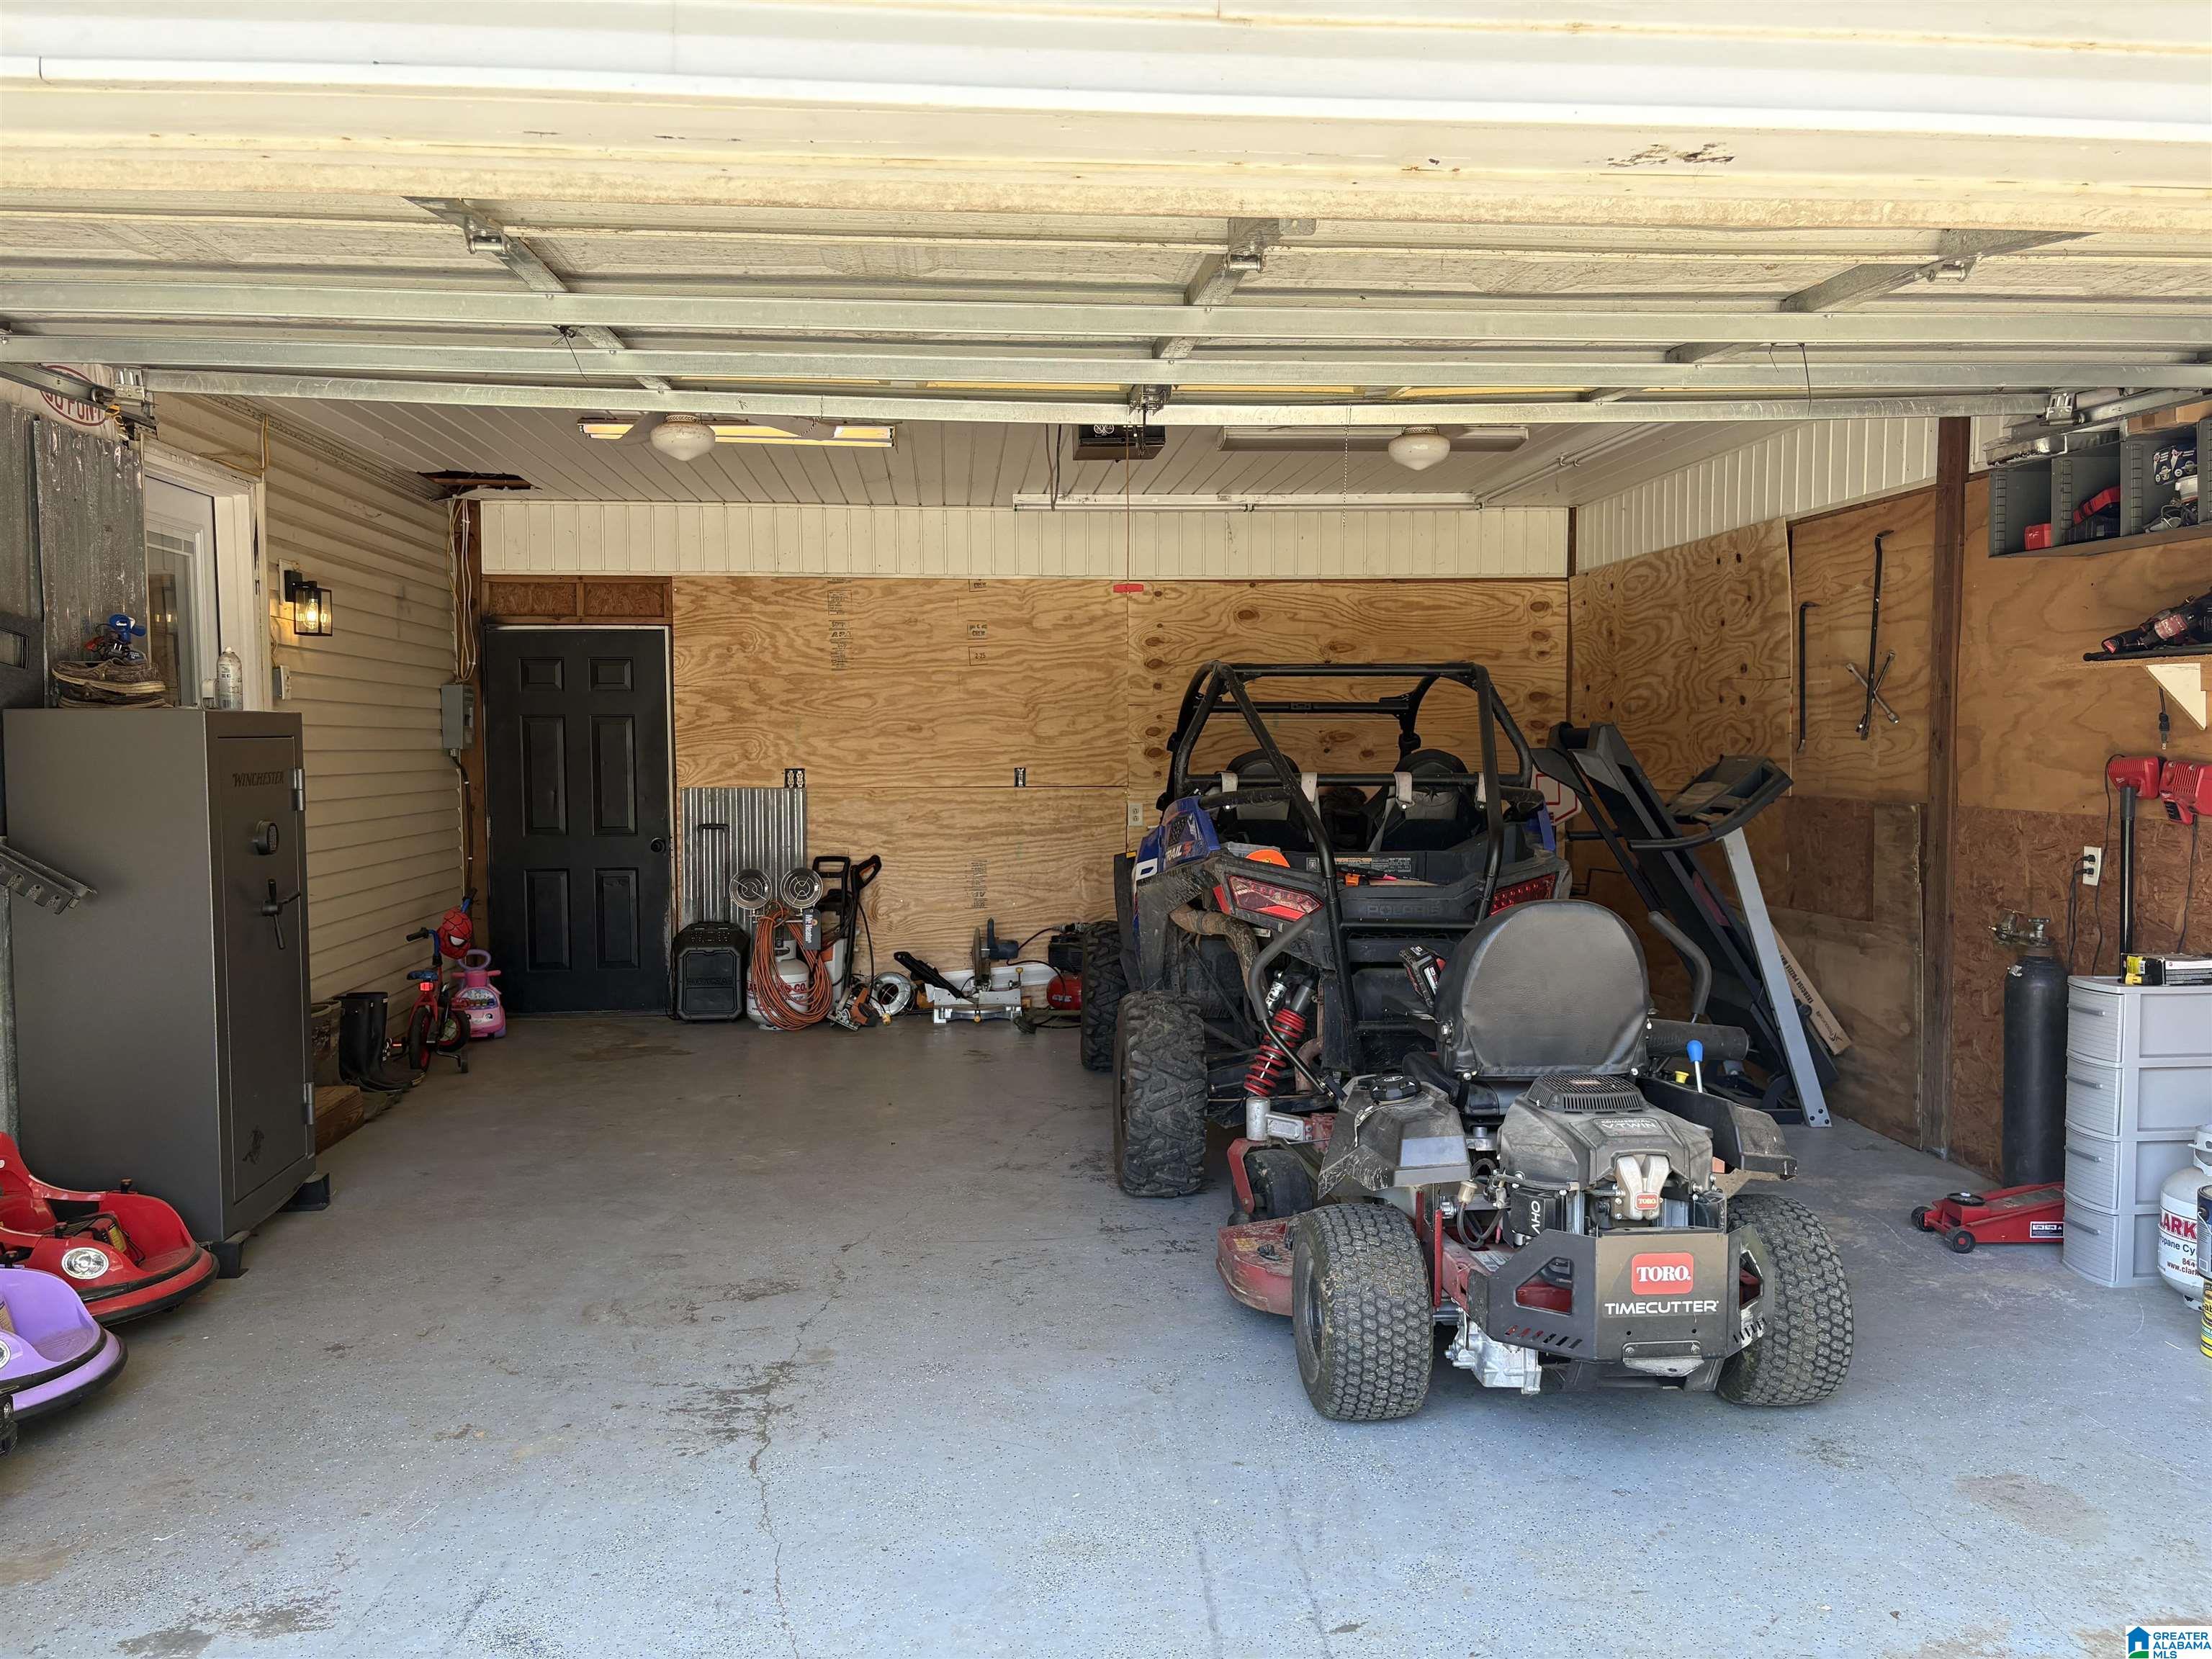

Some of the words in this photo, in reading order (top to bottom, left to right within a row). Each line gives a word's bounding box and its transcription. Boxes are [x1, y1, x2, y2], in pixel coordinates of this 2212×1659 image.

[232, 771, 284, 788] WINCHESTER
[1165, 845, 1182, 863] TRAIL
[1367, 905, 1441, 916] POLARIS
[1796, 981, 1814, 1004] EXERCISE
[1531, 1200, 1541, 1235] OHV
[1604, 1300, 1719, 1315] TIMECUTTER
